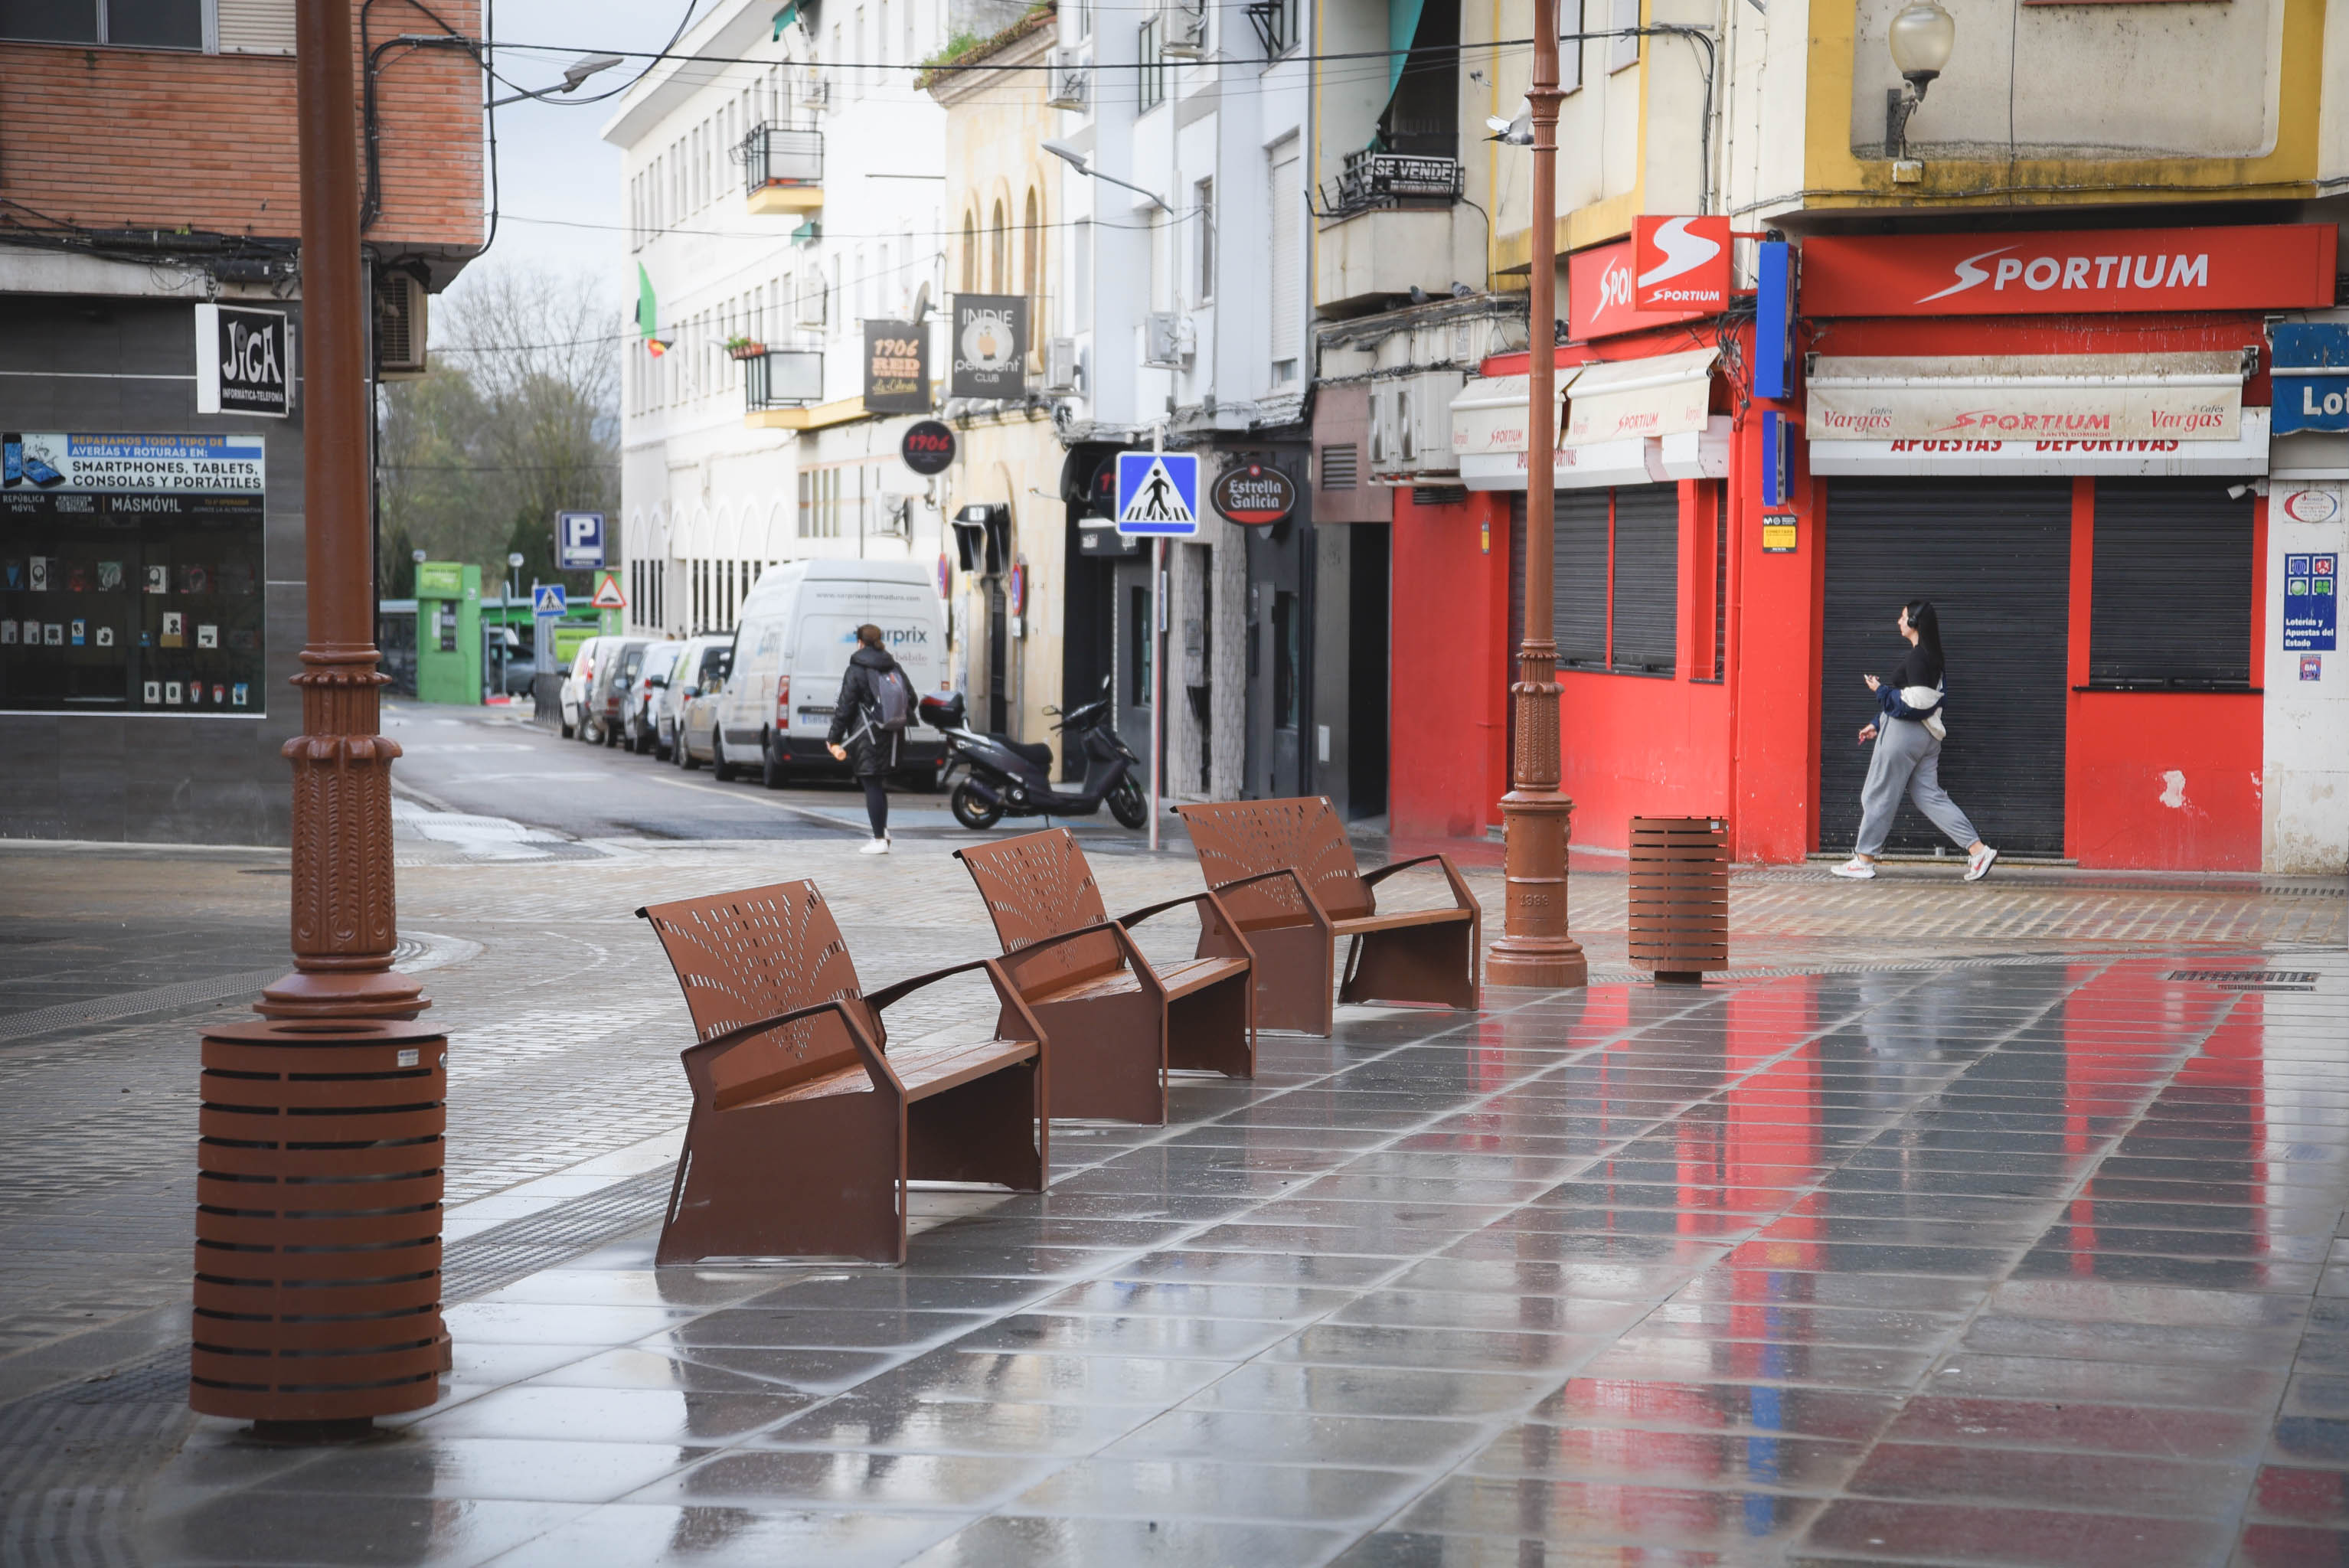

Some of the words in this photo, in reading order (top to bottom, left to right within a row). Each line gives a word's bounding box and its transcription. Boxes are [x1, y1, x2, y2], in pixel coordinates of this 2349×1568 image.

[1374, 160, 1394, 177] SE
[1399, 161, 1452, 181] VENDE
[1914, 243, 2208, 305] SPORTIUM
[1643, 287, 1720, 304] SPORTIUM
[962, 308, 1014, 327] INDIE
[874, 338, 920, 357] 1906
[872, 357, 921, 371] RED
[974, 373, 999, 383] CLUB
[2200, 404, 2225, 414] Cafés
[1611, 412, 1659, 437] SPORTIUM
[1824, 410, 1892, 433] Vargas
[1932, 409, 2111, 433] SPORTIUM
[2151, 410, 2223, 433] Vargas
[71, 435, 142, 446] REPARAMOS
[145, 436, 176, 446] TODO
[179, 436, 206, 446] TIPO
[209, 438, 224, 447] DE
[907, 434, 950, 452] 1906
[1488, 429, 1524, 448] SPORTIUM
[1890, 439, 2003, 452] APUESTAS
[2035, 439, 2179, 452] DEPORTIVAS
[71, 445, 121, 457] AVERÍAS
[123, 446, 131, 456] Y
[133, 447, 187, 457] ROTURAS
[189, 447, 208, 458] EN:
[72, 460, 189, 474] SMARTPHONES,
[193, 462, 258, 475] TABLETS,
[72, 475, 155, 487] CONSOLAS
[159, 475, 169, 488] Y
[173, 473, 261, 488] PORTÁTILES
[1229, 479, 1282, 494] Estrella
[1230, 493, 1279, 508] Galicia
[569, 518, 596, 547] P
[2285, 618, 2317, 626] Loterías
[2318, 619, 2324, 628] y
[2285, 629, 2320, 637] Apuestas
[2321, 628, 2334, 636] del
[2285, 639, 2311, 647] Estado
